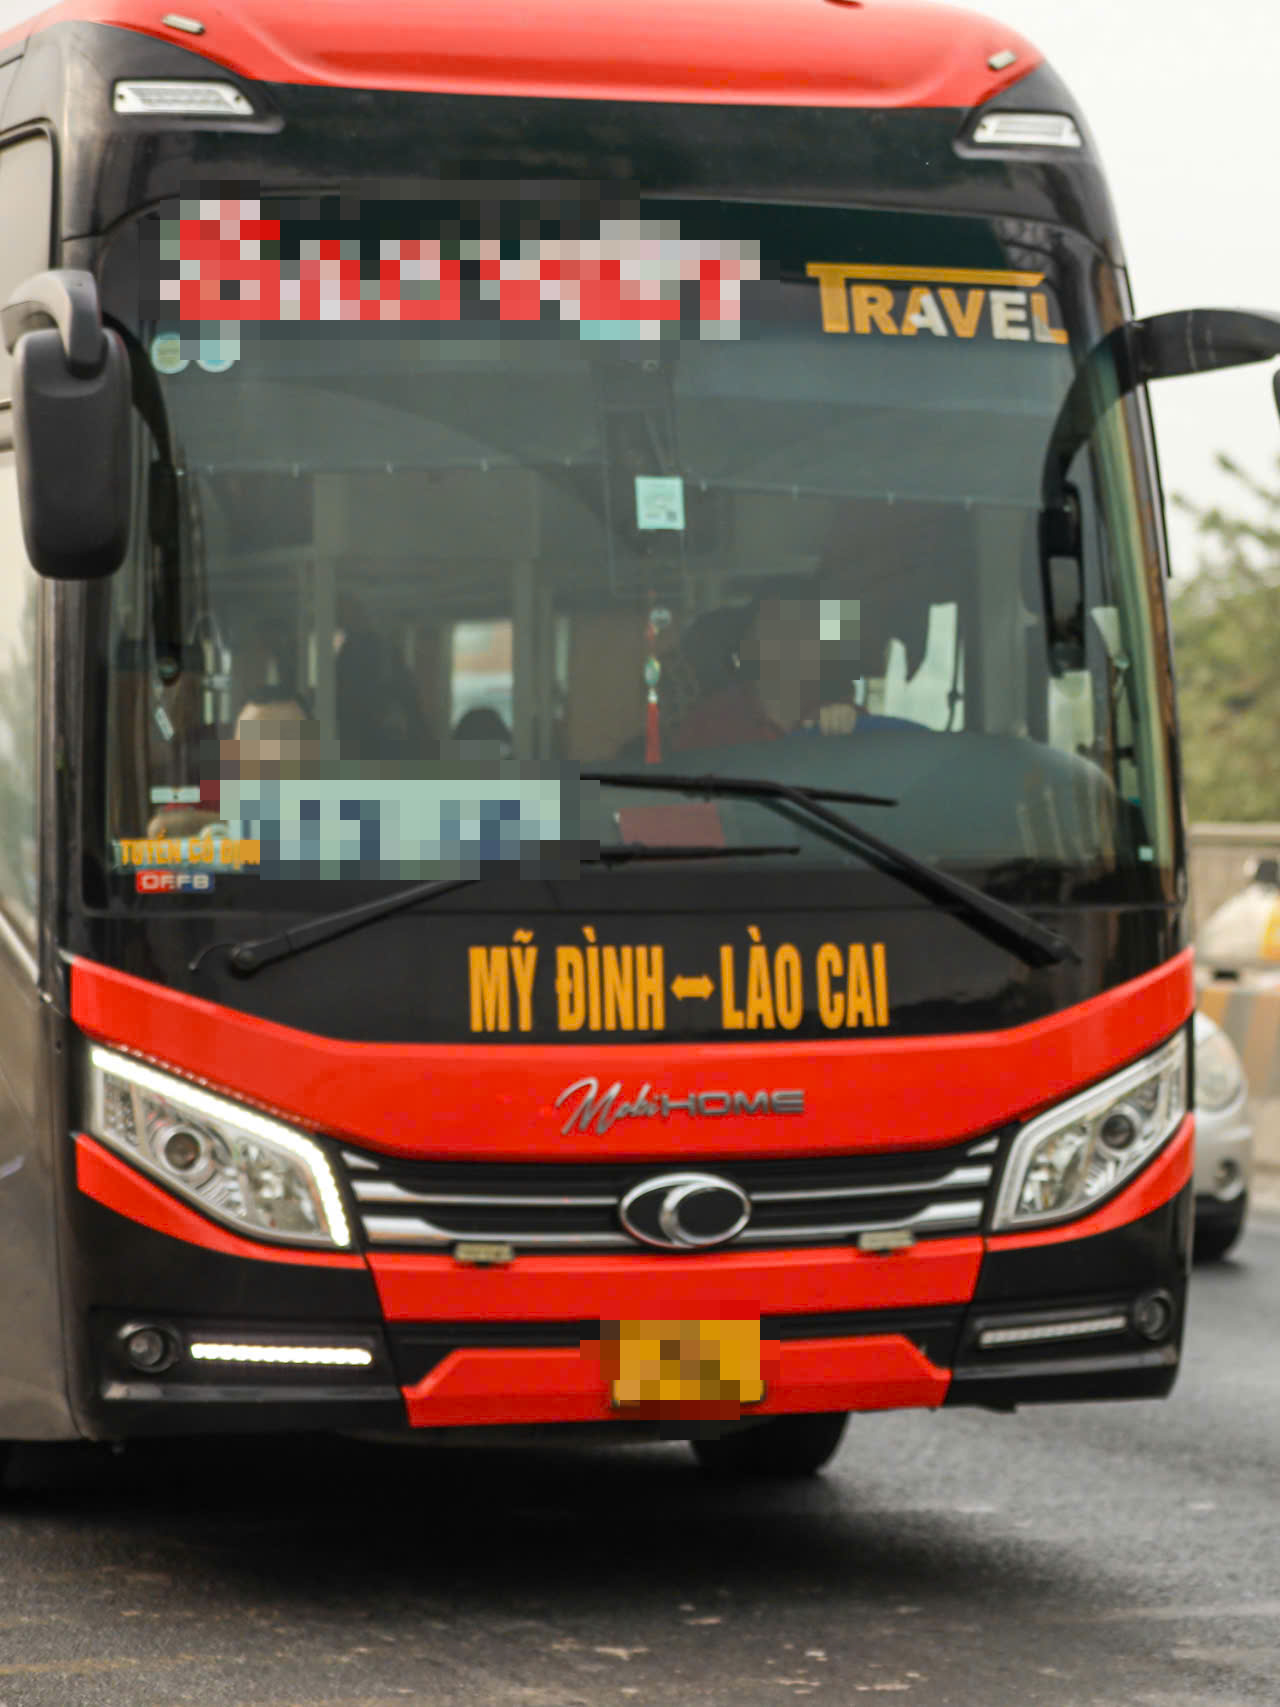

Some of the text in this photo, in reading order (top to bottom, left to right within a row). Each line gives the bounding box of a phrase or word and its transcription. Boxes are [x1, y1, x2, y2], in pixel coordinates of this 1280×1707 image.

[806, 262, 1069, 345] TRAVEL
[469, 925, 890, 1032] MỸ ĐÌNH LÀO CAI
